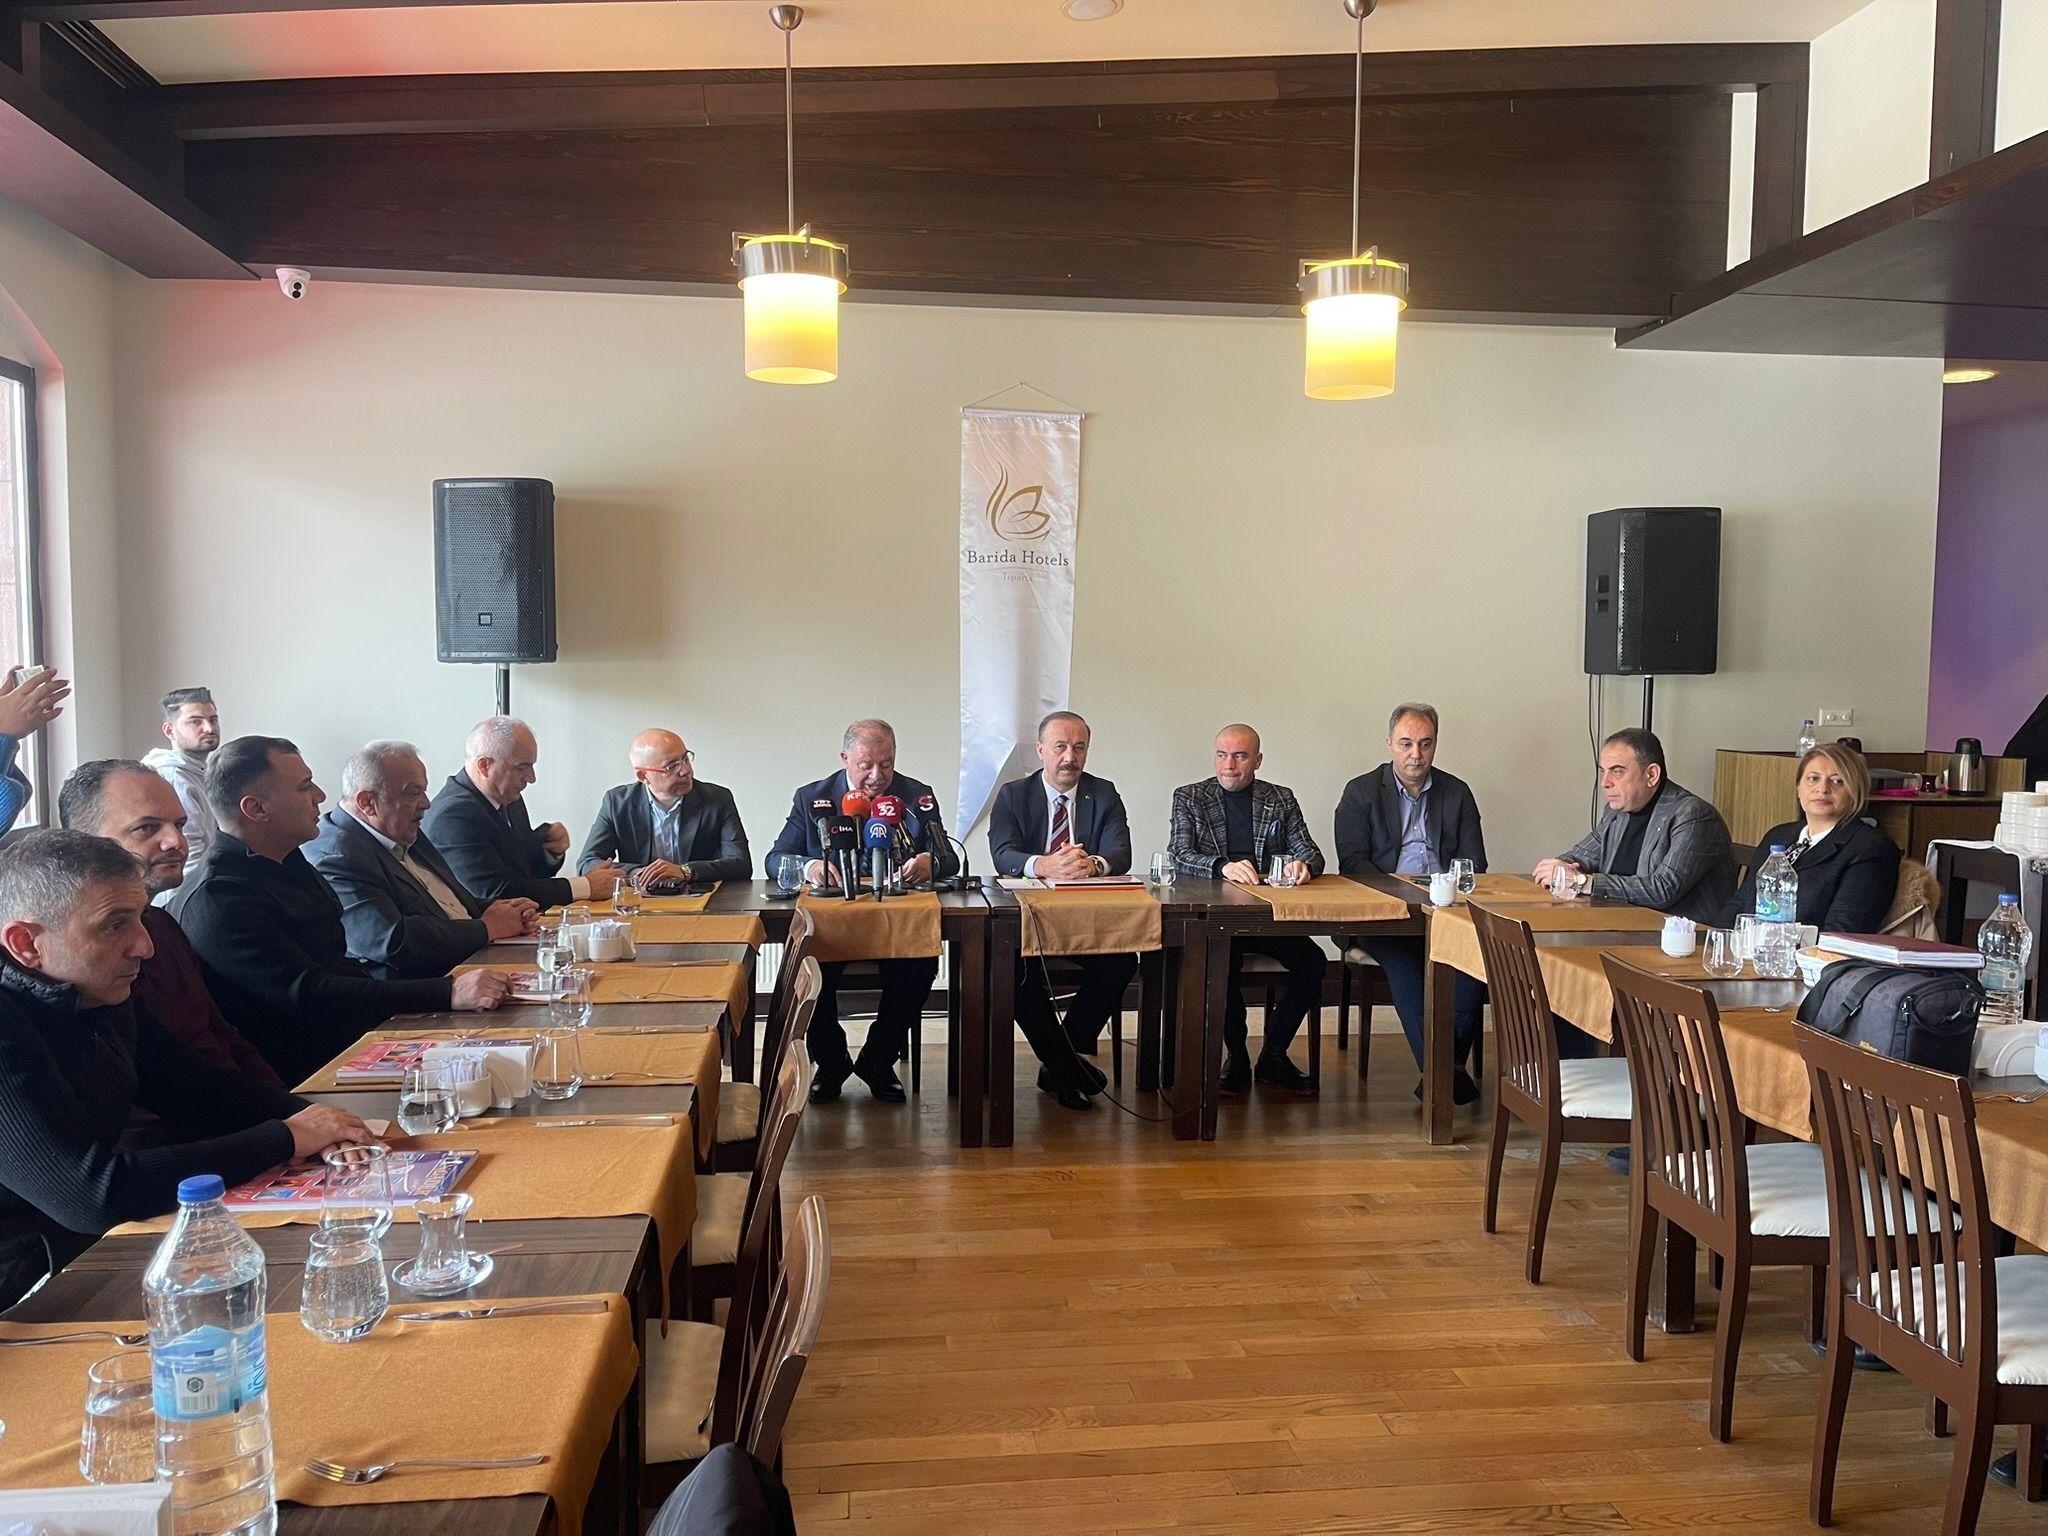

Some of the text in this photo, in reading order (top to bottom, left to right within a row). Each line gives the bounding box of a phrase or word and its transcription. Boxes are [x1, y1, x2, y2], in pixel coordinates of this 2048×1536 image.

[967, 549, 1069, 566] Barida Hotels
[878, 804, 896, 816] 32
[869, 823, 887, 838] AA
